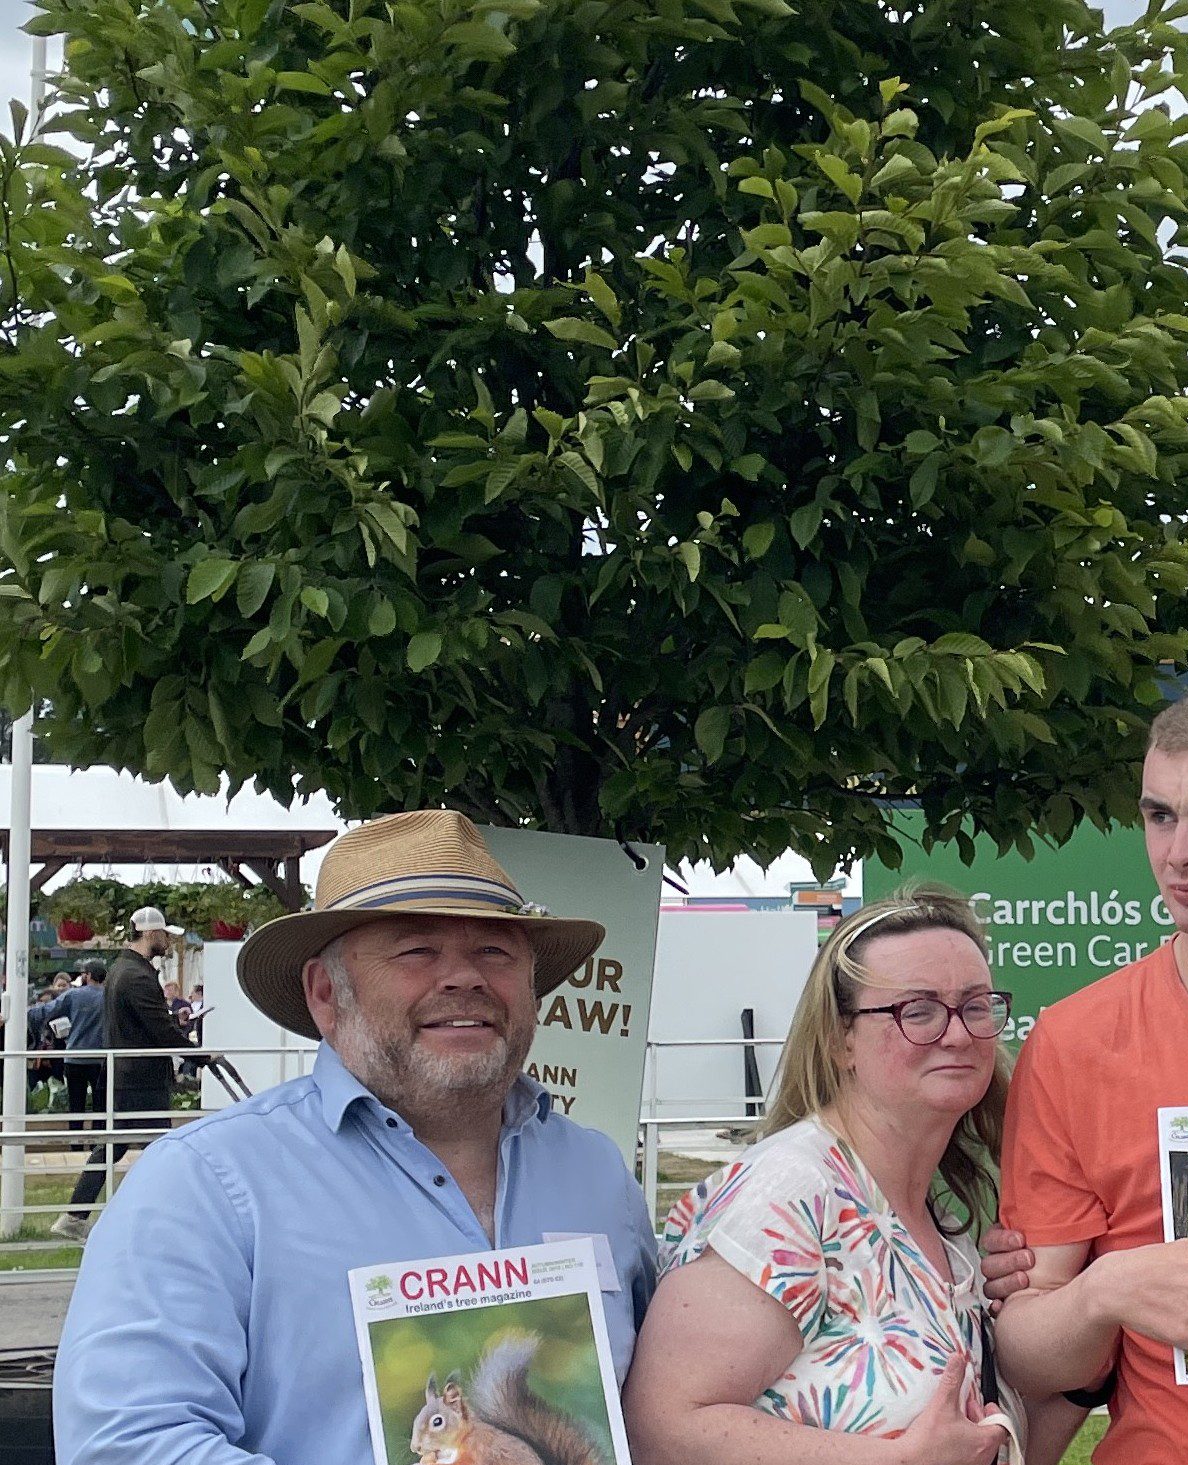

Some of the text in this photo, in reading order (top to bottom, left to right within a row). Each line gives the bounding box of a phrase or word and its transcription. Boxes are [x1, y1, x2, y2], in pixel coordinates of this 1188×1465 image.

[969, 889, 1142, 925] Carrchlós
[1088, 935, 1149, 967] Car
[538, 995, 632, 1037] AW!
[400, 1257, 529, 1300] CRANN
[405, 1288, 532, 1314] Ireland's tree magazine
